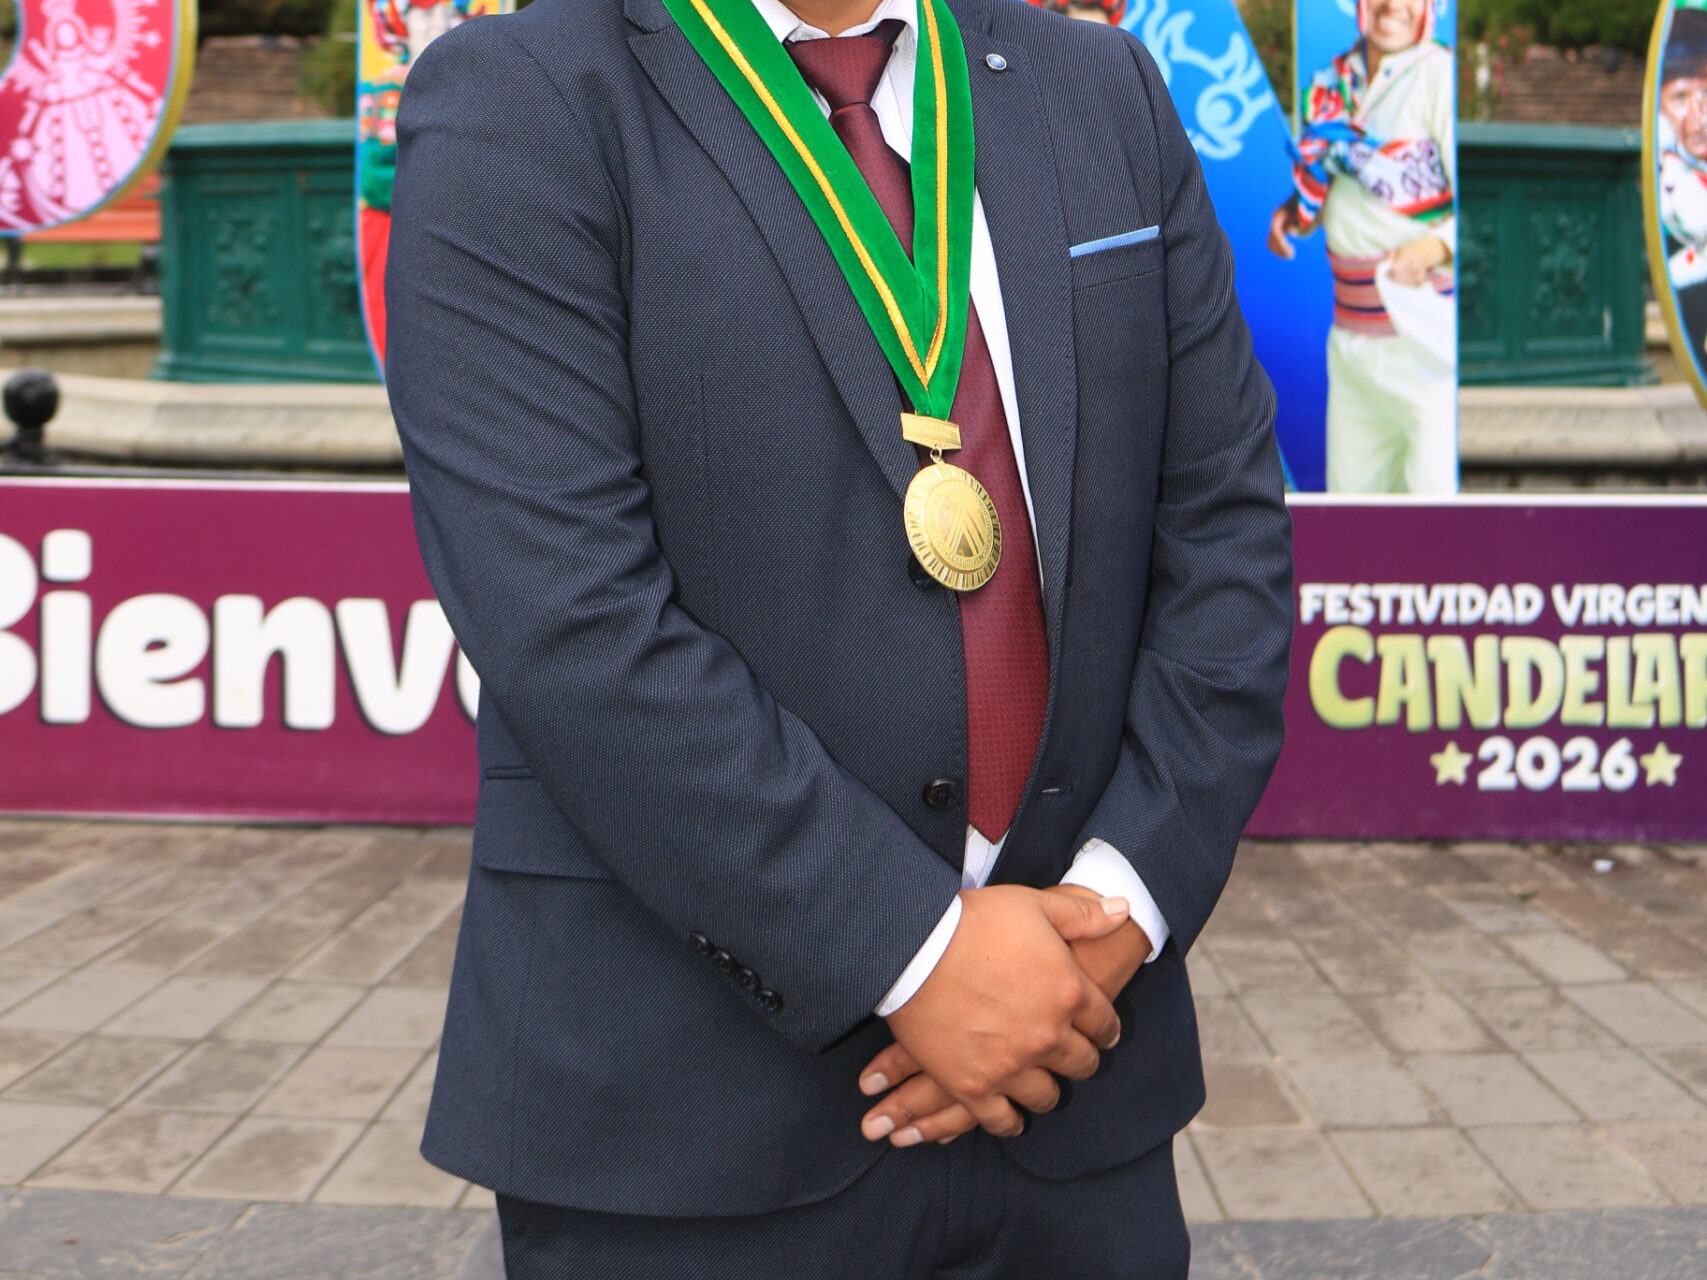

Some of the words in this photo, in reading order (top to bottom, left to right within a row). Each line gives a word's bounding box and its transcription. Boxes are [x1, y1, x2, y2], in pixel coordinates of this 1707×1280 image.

[0, 528, 481, 736] ienv
[1298, 582, 1545, 627] FESTIVIDAD
[1550, 582, 1707, 628] VIRGEN
[1476, 734, 1640, 792] 2026
